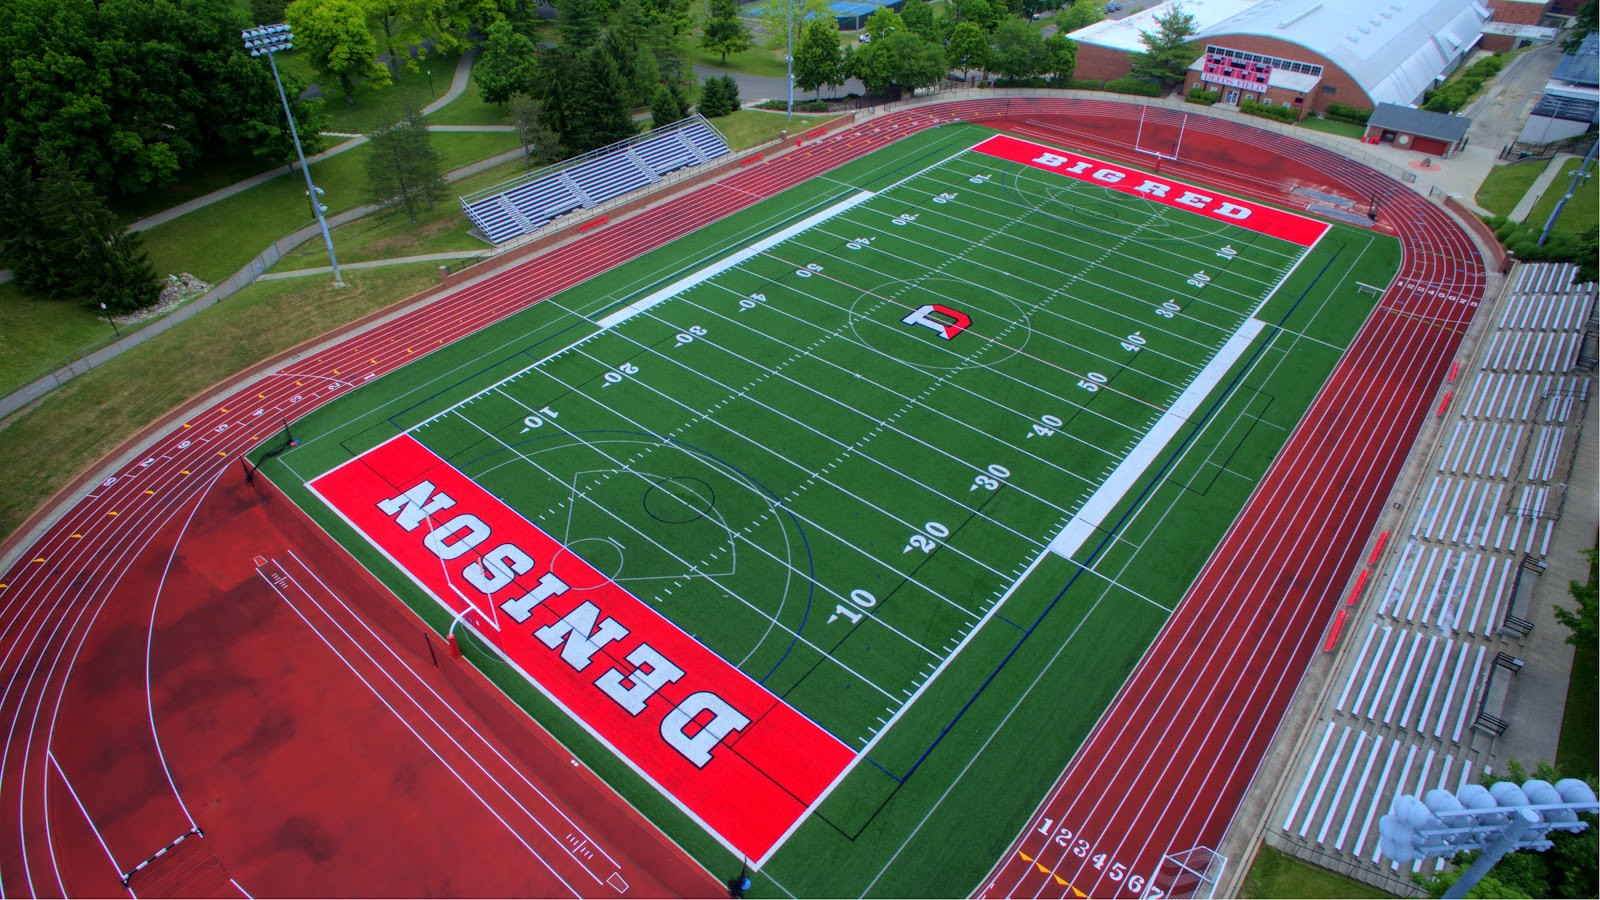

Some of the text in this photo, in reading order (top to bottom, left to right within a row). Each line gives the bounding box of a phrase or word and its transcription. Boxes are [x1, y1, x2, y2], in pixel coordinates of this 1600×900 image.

[1204, 74, 1264, 91] DEEDS FIELD
[1031, 152, 1253, 220] BIG RED
[933, 193, 954, 204] 20
[892, 214, 916, 226] 30
[846, 237, 870, 250] 40
[1216, 247, 1237, 260] 10
[796, 264, 824, 278] 50
[1187, 273, 1211, 288] 20
[739, 294, 766, 308] 40
[1155, 302, 1181, 318] 30
[676, 326, 708, 343] 30
[1120, 334, 1147, 352] 40
[604, 363, 639, 383] 20
[1077, 372, 1107, 392] 50
[524, 406, 559, 428] 10
[1032, 415, 1063, 436] 40
[103, 372, 376, 487] 1 2 3 4 5 6 7 8
[975, 464, 1010, 490] 30
[909, 522, 949, 553] 20
[836, 589, 877, 624] 10
[375, 479, 752, 770] DENISON
[1037, 818, 1053, 836] 1
[1055, 828, 1072, 846] 2
[1073, 839, 1090, 858] 3
[1091, 853, 1107, 870] 4
[1109, 862, 1127, 881] 5
[1128, 875, 1145, 893] 6
